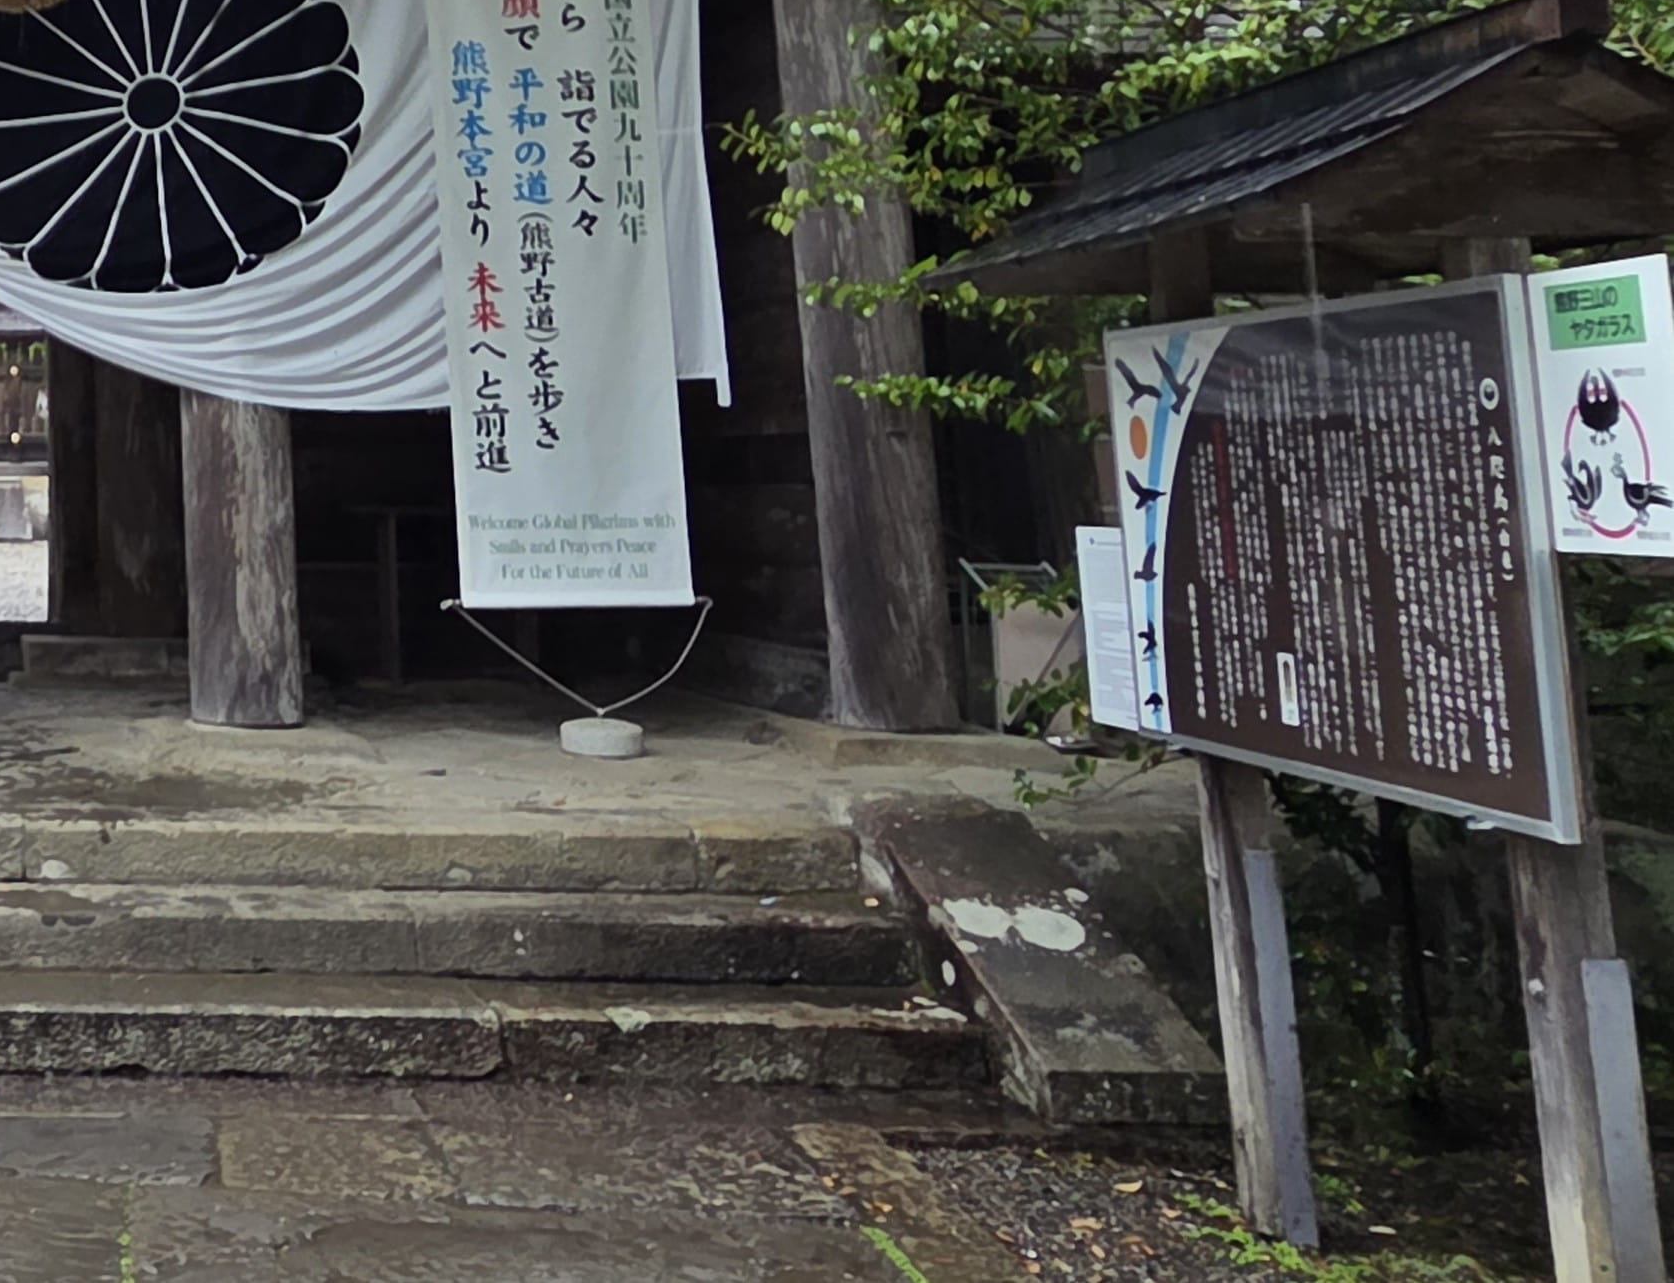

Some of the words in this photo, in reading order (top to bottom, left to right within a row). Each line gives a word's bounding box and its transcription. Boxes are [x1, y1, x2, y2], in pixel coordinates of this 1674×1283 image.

[468, 514, 529, 530] Welcome
[532, 513, 576, 530] Global
[643, 512, 676, 529] with
[530, 537, 556, 554] and
[560, 538, 614, 557] Prayers
[616, 538, 657, 554] Peace
[501, 564, 525, 580] For
[530, 564, 553, 580] the
[557, 564, 603, 580] Future
[608, 564, 622, 580] of
[628, 563, 649, 579] All
